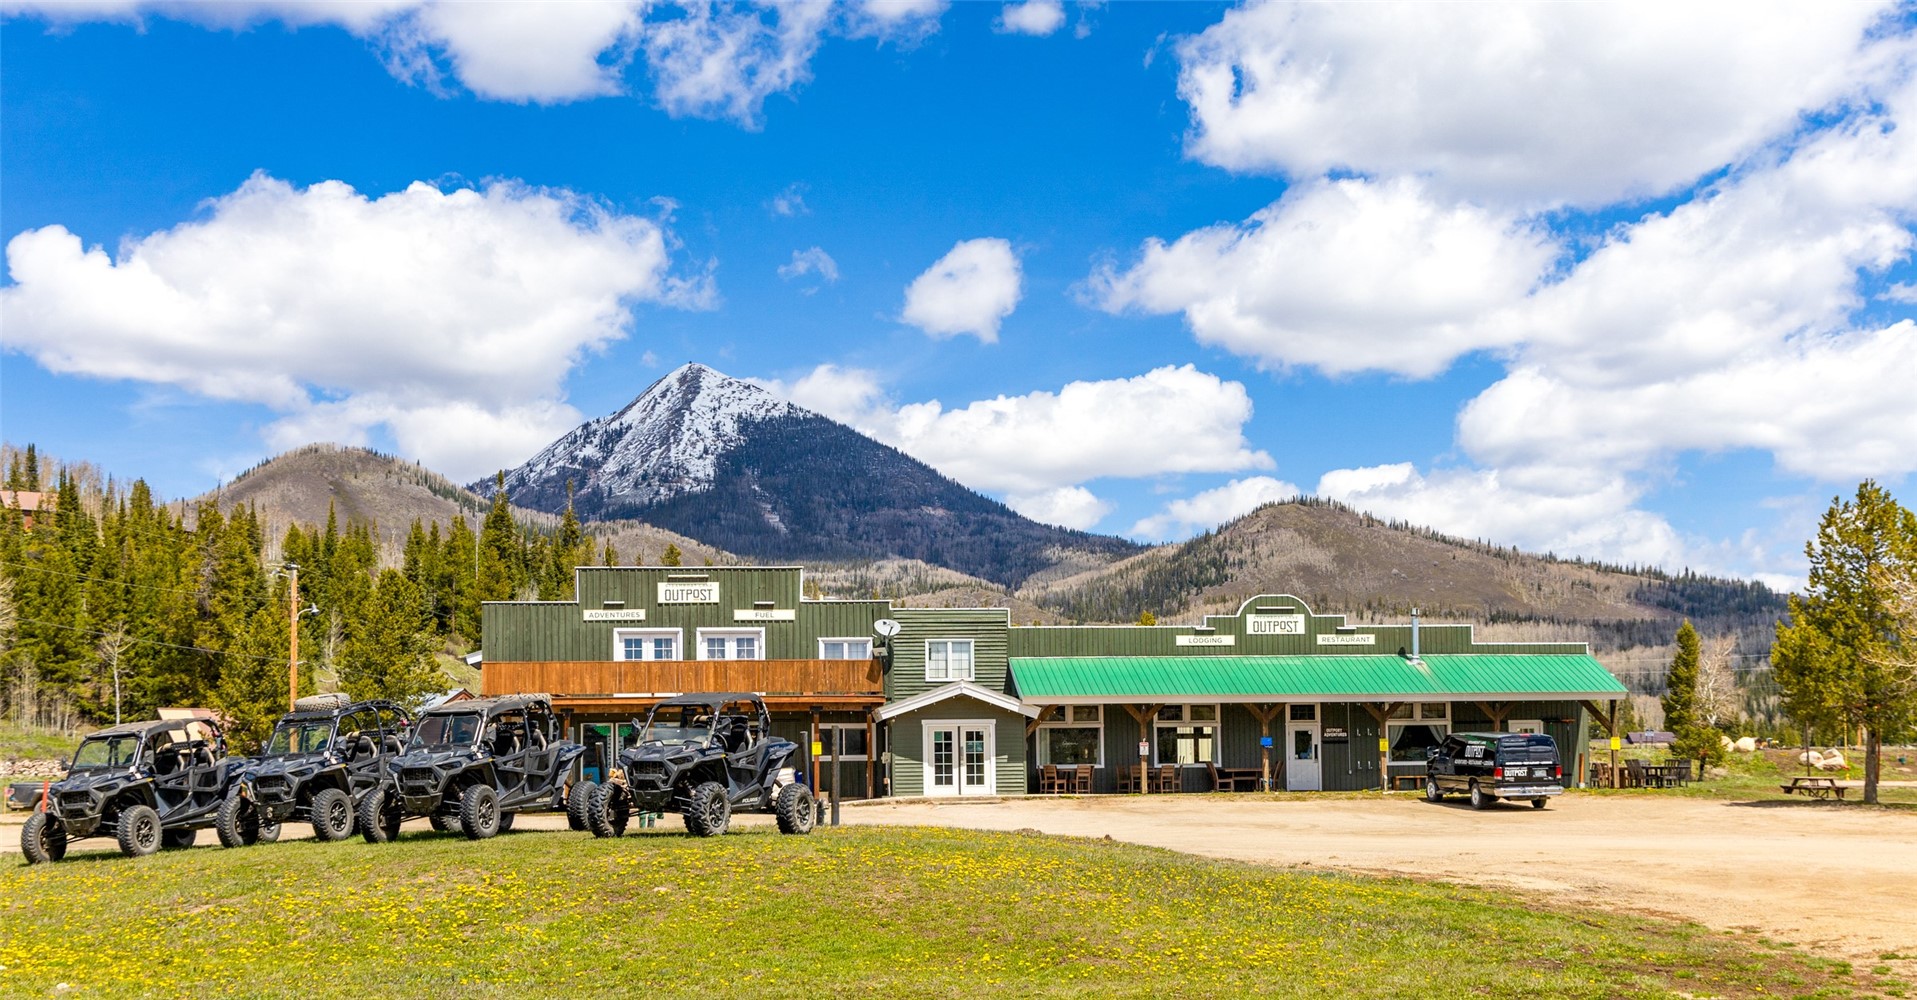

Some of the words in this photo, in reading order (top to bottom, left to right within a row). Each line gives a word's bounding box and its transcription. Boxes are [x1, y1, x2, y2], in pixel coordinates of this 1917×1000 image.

[664, 588, 713, 601] OUTPOST
[1252, 620, 1299, 633] OUTPOST
[1504, 769, 1528, 777] OUTPOST
